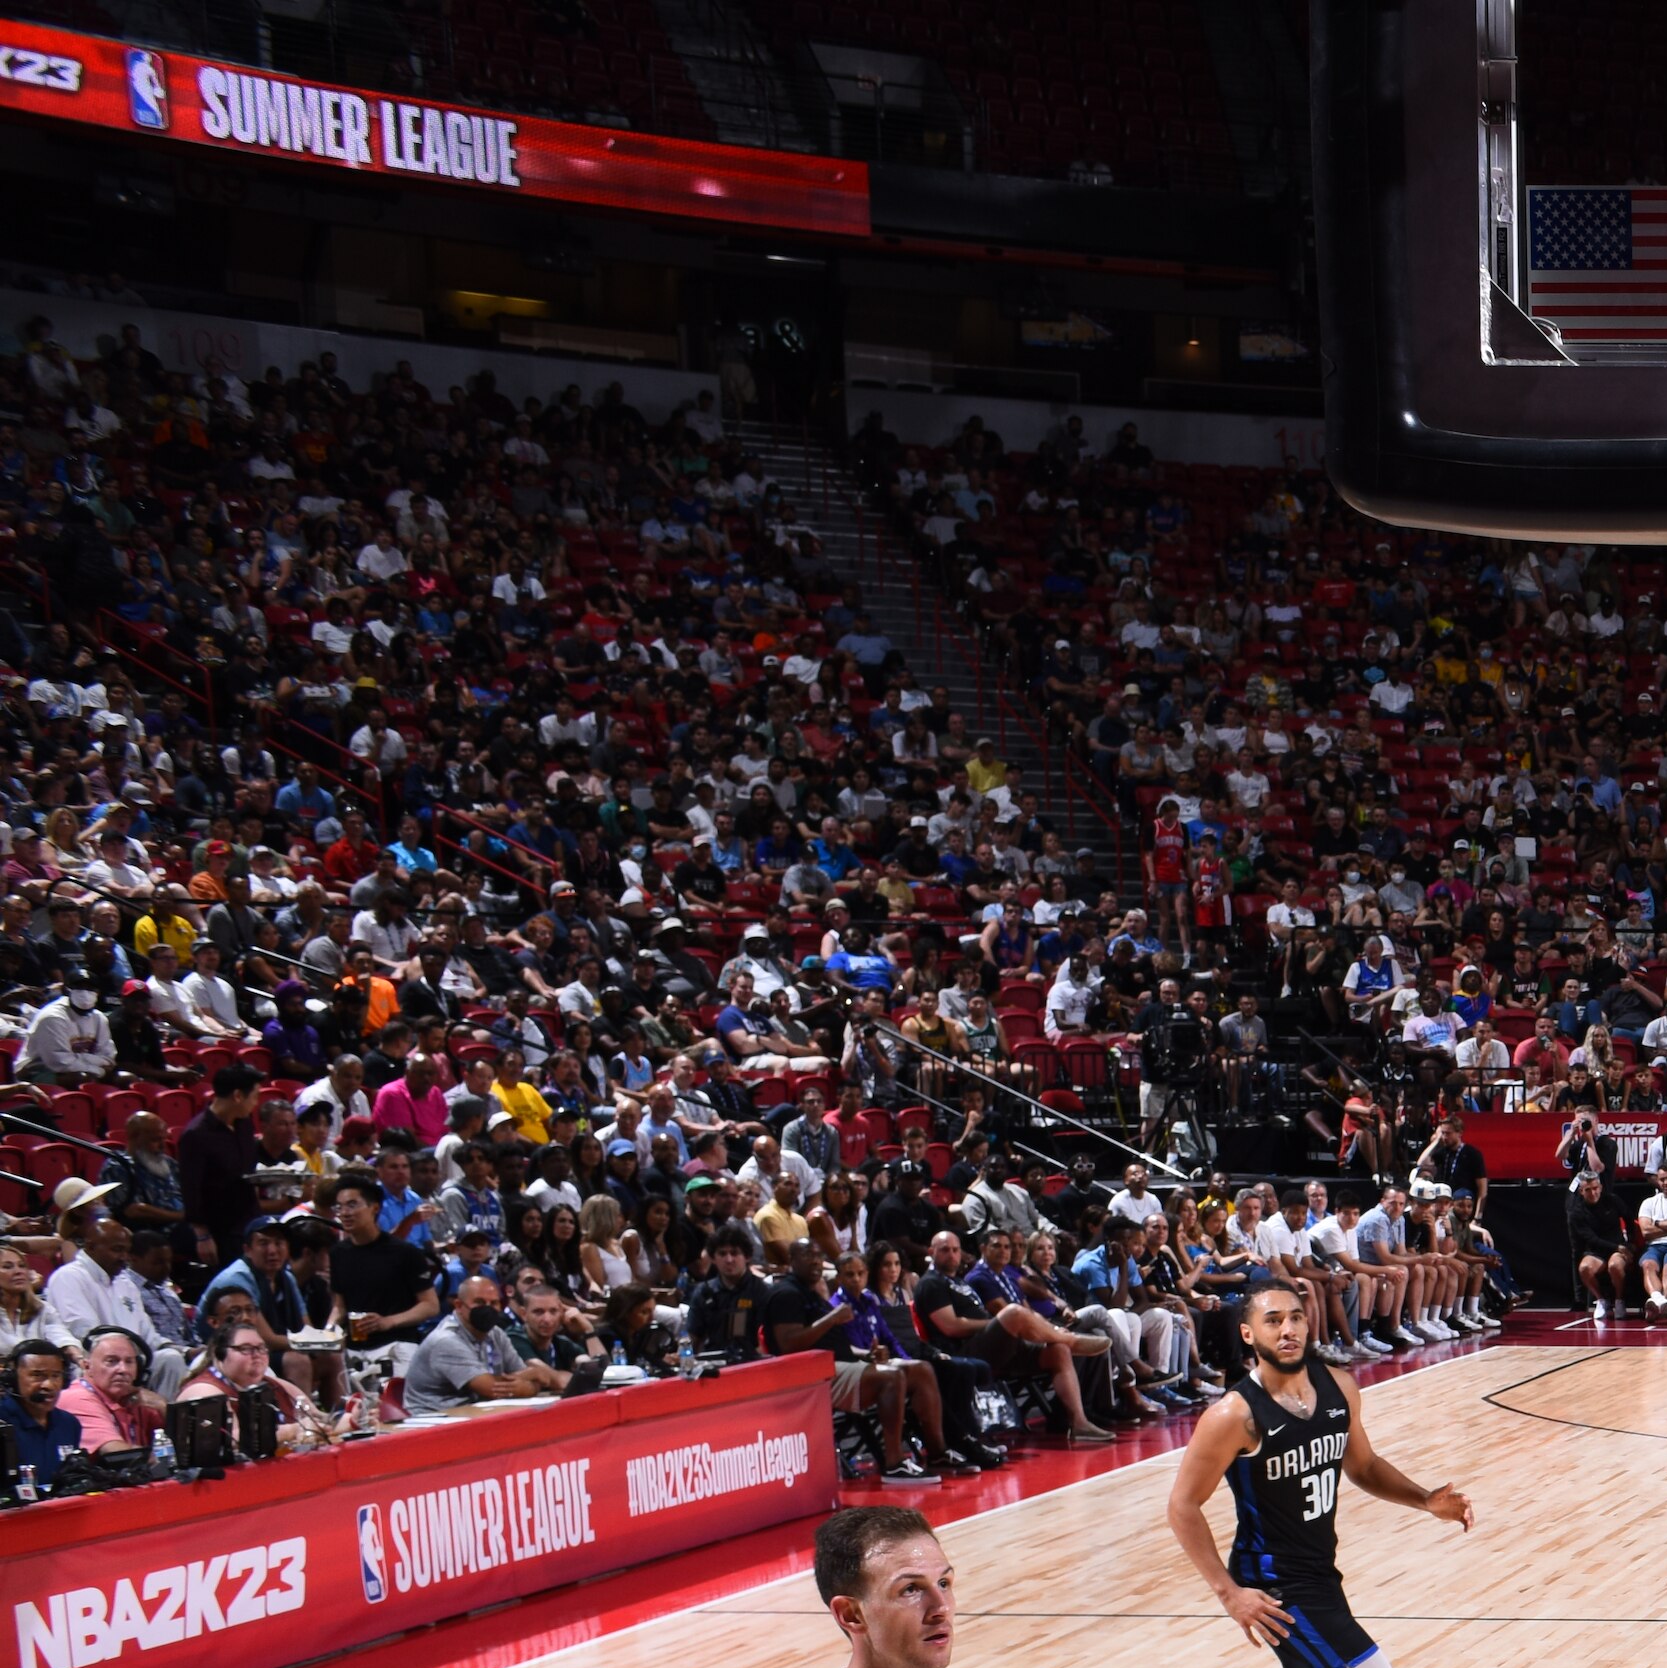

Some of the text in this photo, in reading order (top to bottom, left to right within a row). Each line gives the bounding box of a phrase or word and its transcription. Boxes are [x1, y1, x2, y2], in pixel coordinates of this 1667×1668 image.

[198, 66, 521, 188] SUMMER LEAGUE
[626, 1429, 810, 1517] #NBA2K23SummerLeague
[1301, 1468, 1336, 1522] 30
[389, 1457, 597, 1595] SUMMER LEAGUE
